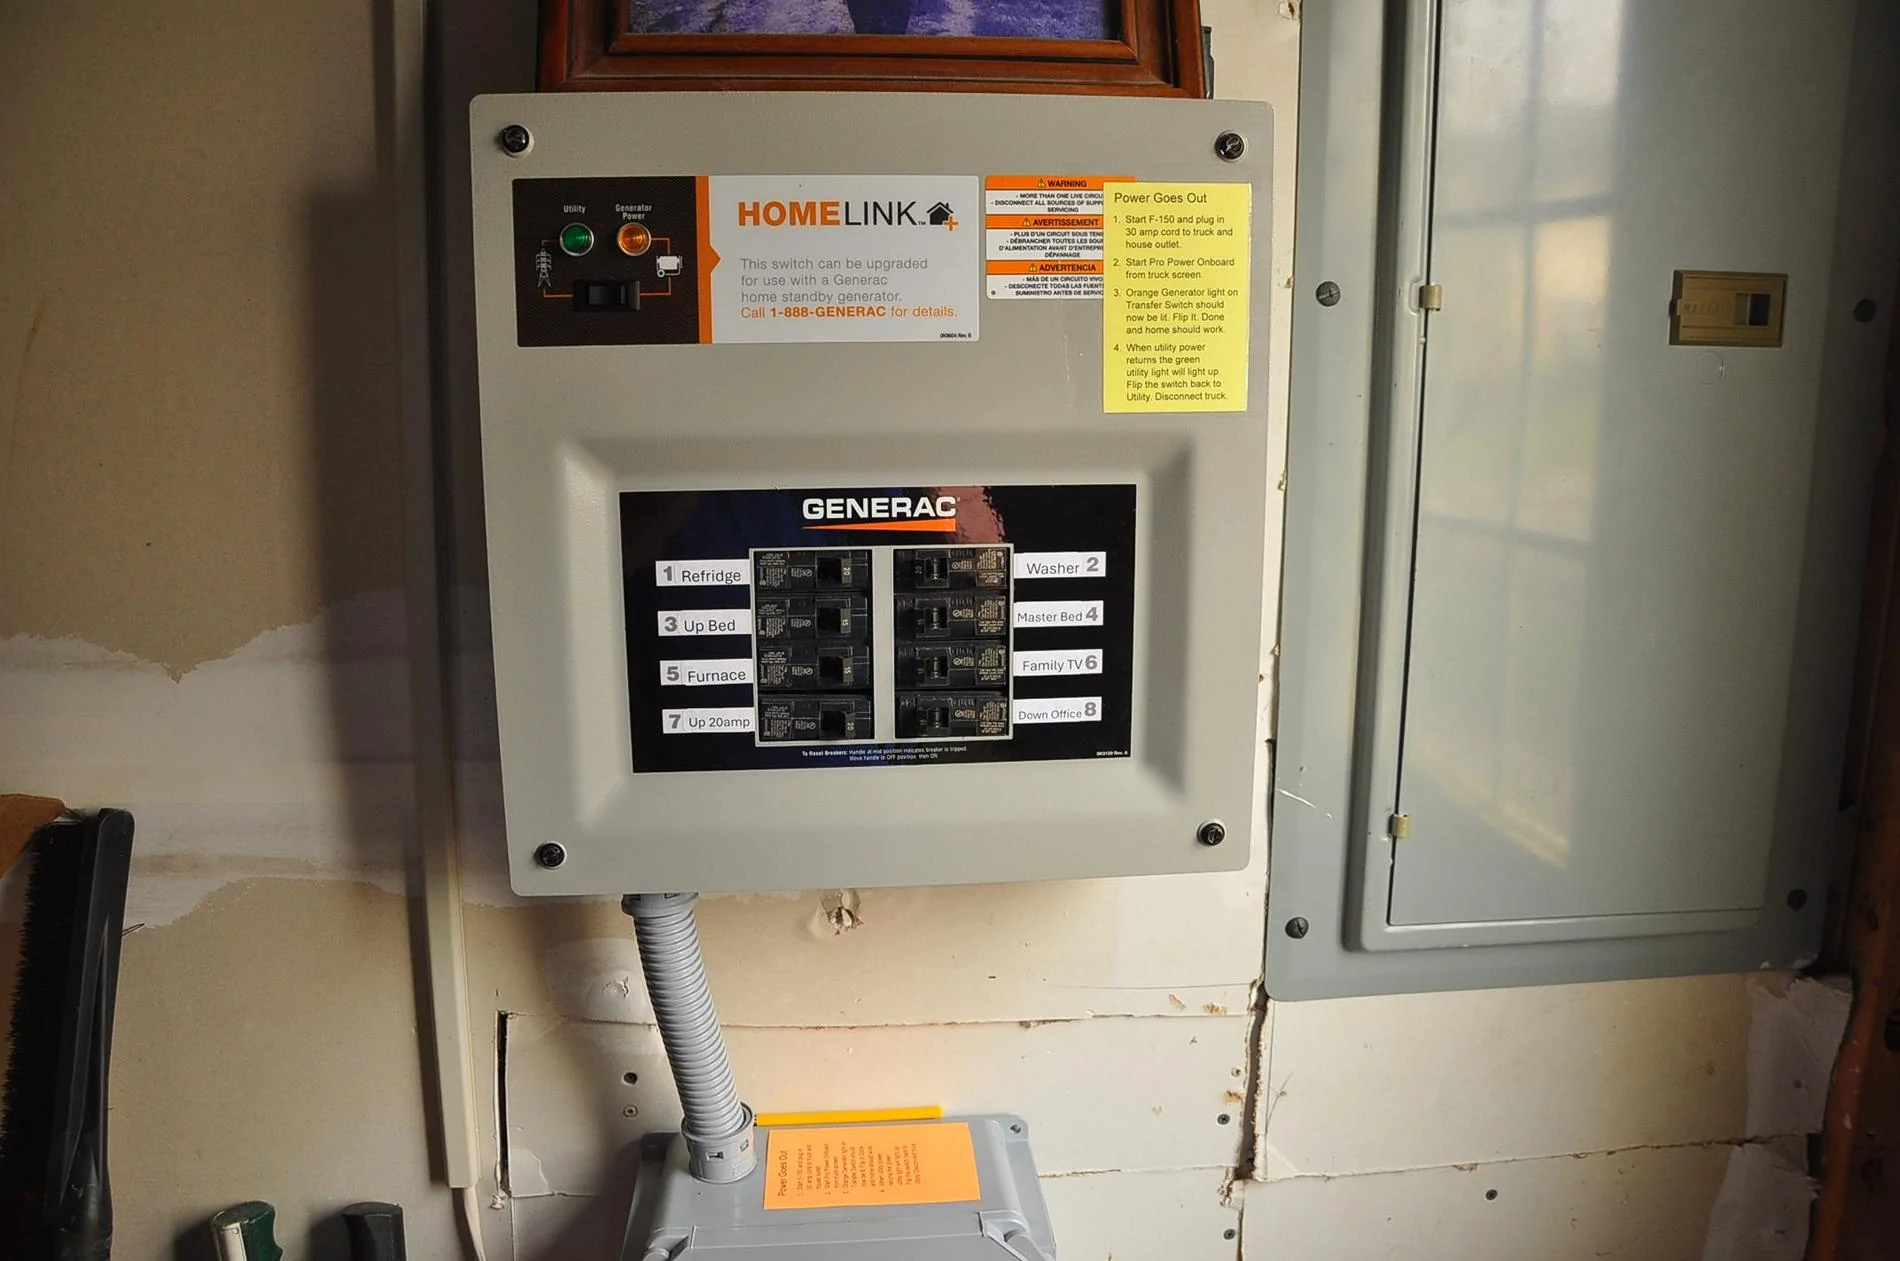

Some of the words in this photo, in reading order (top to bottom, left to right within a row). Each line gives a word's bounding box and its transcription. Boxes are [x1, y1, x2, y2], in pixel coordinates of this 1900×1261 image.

[1114, 193, 1150, 203] Power
[1153, 193, 1183, 203] Goes
[1187, 193, 1207, 203] Out
[563, 205, 586, 214] Utility
[615, 204, 652, 212] Generator
[737, 200, 917, 226] HOMELINK
[623, 212, 645, 220] Power
[1126, 215, 1146, 223] Start
[1149, 215, 1174, 223] F-150
[1177, 215, 1194, 223] and
[1196, 215, 1214, 226] plug
[1217, 215, 1224, 223] in
[1126, 228, 1136, 236] 30
[1139, 229, 1158, 239] amp
[1161, 228, 1180, 236] cord
[1183, 228, 1190, 236] to
[1193, 228, 1215, 236] truck
[1126, 240, 1152, 248] house
[1155, 240, 1181, 248] outlet.
[740, 258, 767, 270] This
[771, 258, 814, 270] switch
[818, 260, 841, 269] can
[846, 258, 862, 269] be
[866, 258, 928, 271] upgraded
[1113, 259, 1120, 267] 2.
[1126, 258, 1147, 266] Start
[1150, 258, 1164, 266] Pro
[1167, 258, 1194, 266] Power
[1197, 258, 1235, 266] Onboard
[741, 275, 757, 286] for
[763, 276, 785, 286] use
[790, 275, 816, 286] with
[822, 276, 829, 285] a
[834, 275, 888, 286] Generac
[1126, 271, 1146, 279] from
[1148, 271, 1170, 279] truck
[741, 291, 777, 302] home
[782, 291, 833, 303] standby
[838, 292, 902, 303] generator.
[1114, 289, 1121, 297] 3.
[1126, 289, 1158, 298] Orange
[1162, 289, 1204, 297] Generator
[1208, 288, 1225, 297] light
[1127, 301, 1162, 309] Transfer
[1165, 301, 1193, 309] Switch
[1196, 301, 1224, 309] should
[741, 307, 765, 318] Call
[770, 306, 886, 317] 1-888-GENERAC
[890, 306, 907, 317] for
[913, 306, 958, 317] details.
[1147, 313, 1157, 321] be
[1160, 313, 1169, 321] lit.
[1173, 313, 1188, 323] Flip
[1202, 313, 1224, 321] Done
[1126, 326, 1142, 334] and
[1145, 326, 1169, 334] home
[1172, 325, 1201, 333] should
[1203, 325, 1225, 333] work.
[1114, 344, 1121, 352] 4.
[1126, 343, 1152, 351] When
[1155, 343, 1177, 353] utility
[1179, 344, 1205, 352] power
[1127, 356, 1156, 364] returns
[1159, 356, 1173, 364] the
[1175, 357, 1200, 366] green
[1127, 369, 1148, 378] utility
[1151, 369, 1169, 378] light
[1188, 368, 1205, 377] light
[1127, 382, 1142, 390] Flip
[1145, 381, 1158, 389] the
[1161, 381, 1188, 389] switch
[1191, 380, 1211, 388] back
[1127, 394, 1152, 403] Utility.
[1155, 393, 1203, 401] Disconnect
[802, 496, 957, 519] GENERAC
[1027, 562, 1079, 575] Washer
[1086, 557, 1099, 571] 2
[663, 566, 672, 581] 1
[681, 570, 741, 584] Refridge
[1017, 612, 1057, 622] Master
[1060, 611, 1082, 622] Bed
[1086, 607, 1098, 621] 4
[664, 617, 678, 632] 3
[684, 620, 704, 634] Up
[708, 619, 736, 631] Bed
[1023, 660, 1064, 673] Family
[1067, 659, 1083, 670] TV
[1085, 655, 1097, 670] 6
[666, 666, 680, 682] 5
[687, 670, 746, 682] Furnace
[1018, 710, 1049, 720] Down
[1052, 709, 1082, 720] Office
[1084, 701, 1096, 717] 8
[668, 714, 681, 729] 7
[689, 717, 706, 728] Up
[709, 717, 751, 729] 20amp
[779, 1150, 788, 1161] Out
[778, 1161, 788, 1177] Goes
[778, 1177, 788, 1196] Power
